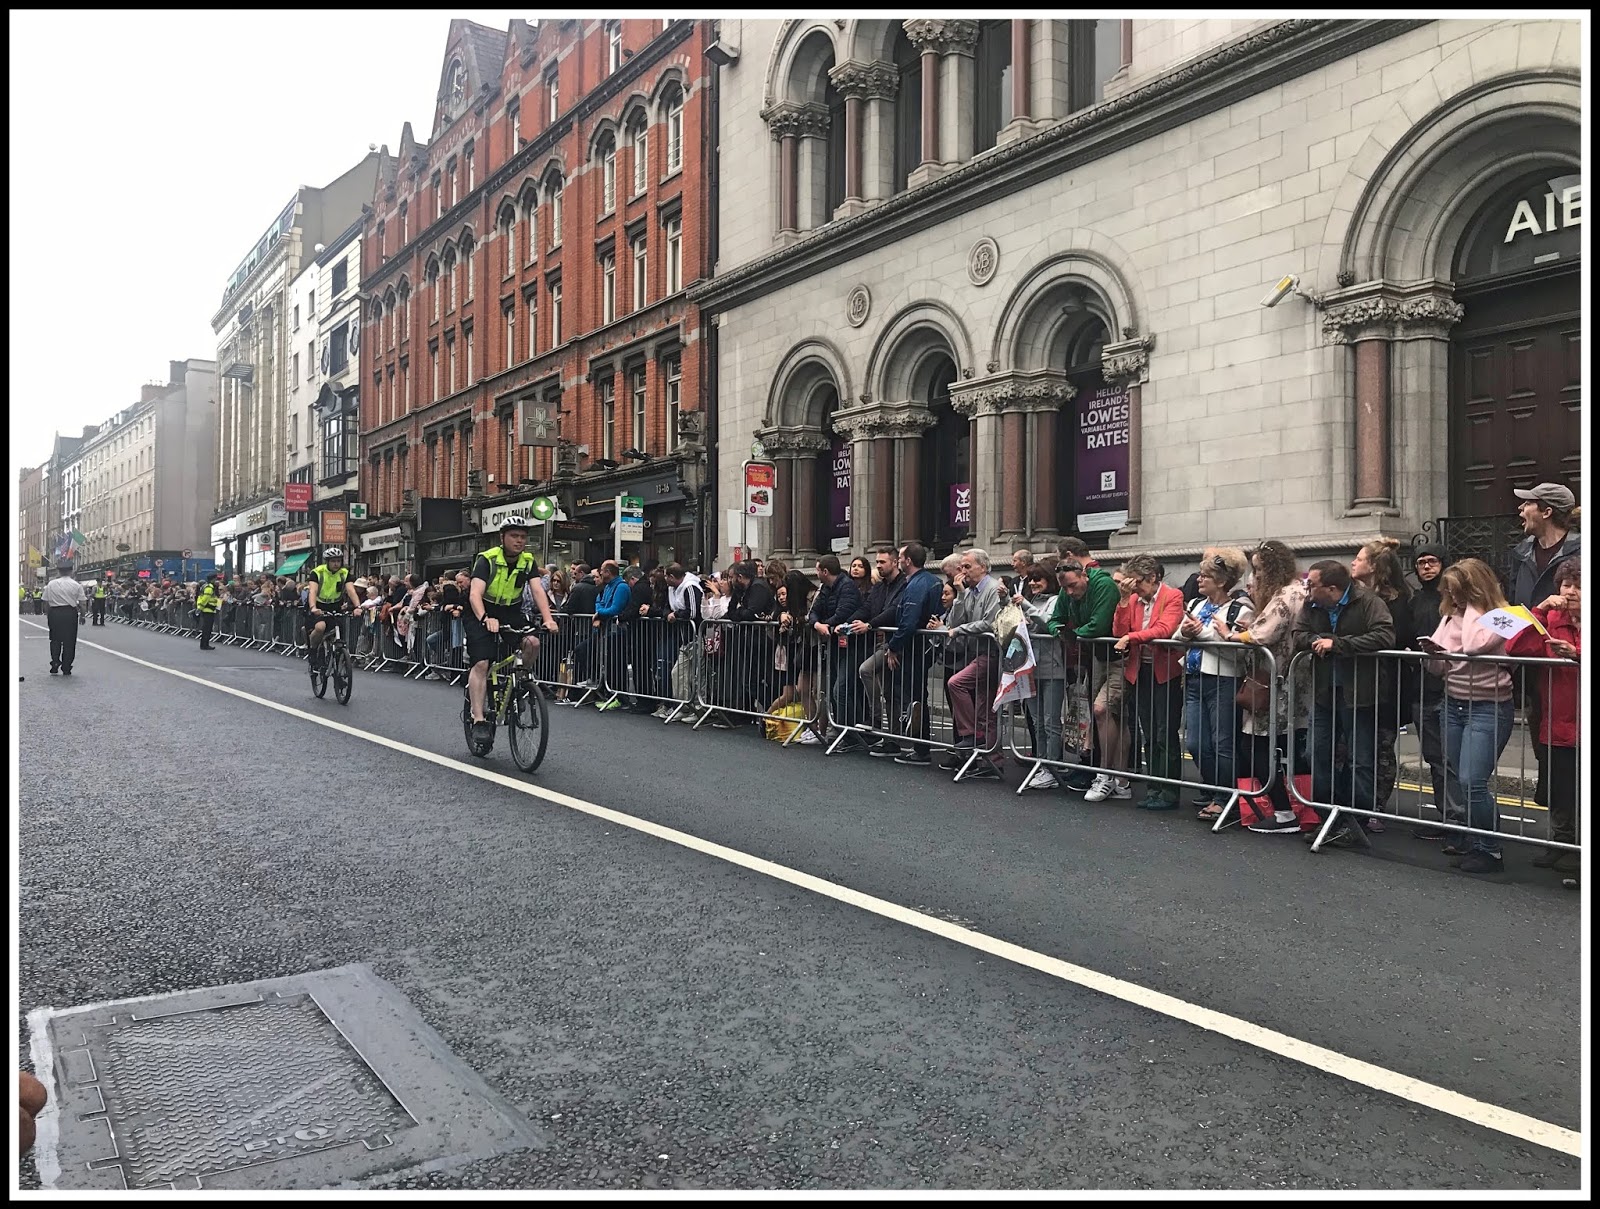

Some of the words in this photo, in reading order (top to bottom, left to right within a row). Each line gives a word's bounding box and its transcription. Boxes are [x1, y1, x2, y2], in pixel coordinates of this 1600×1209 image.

[1096, 386, 1121, 398] HELLO
[1089, 394, 1129, 410] IRELAND'S
[1081, 424, 1106, 434] VARIABLE
[1107, 420, 1128, 430] MORTG
[1087, 428, 1129, 449] RATES
